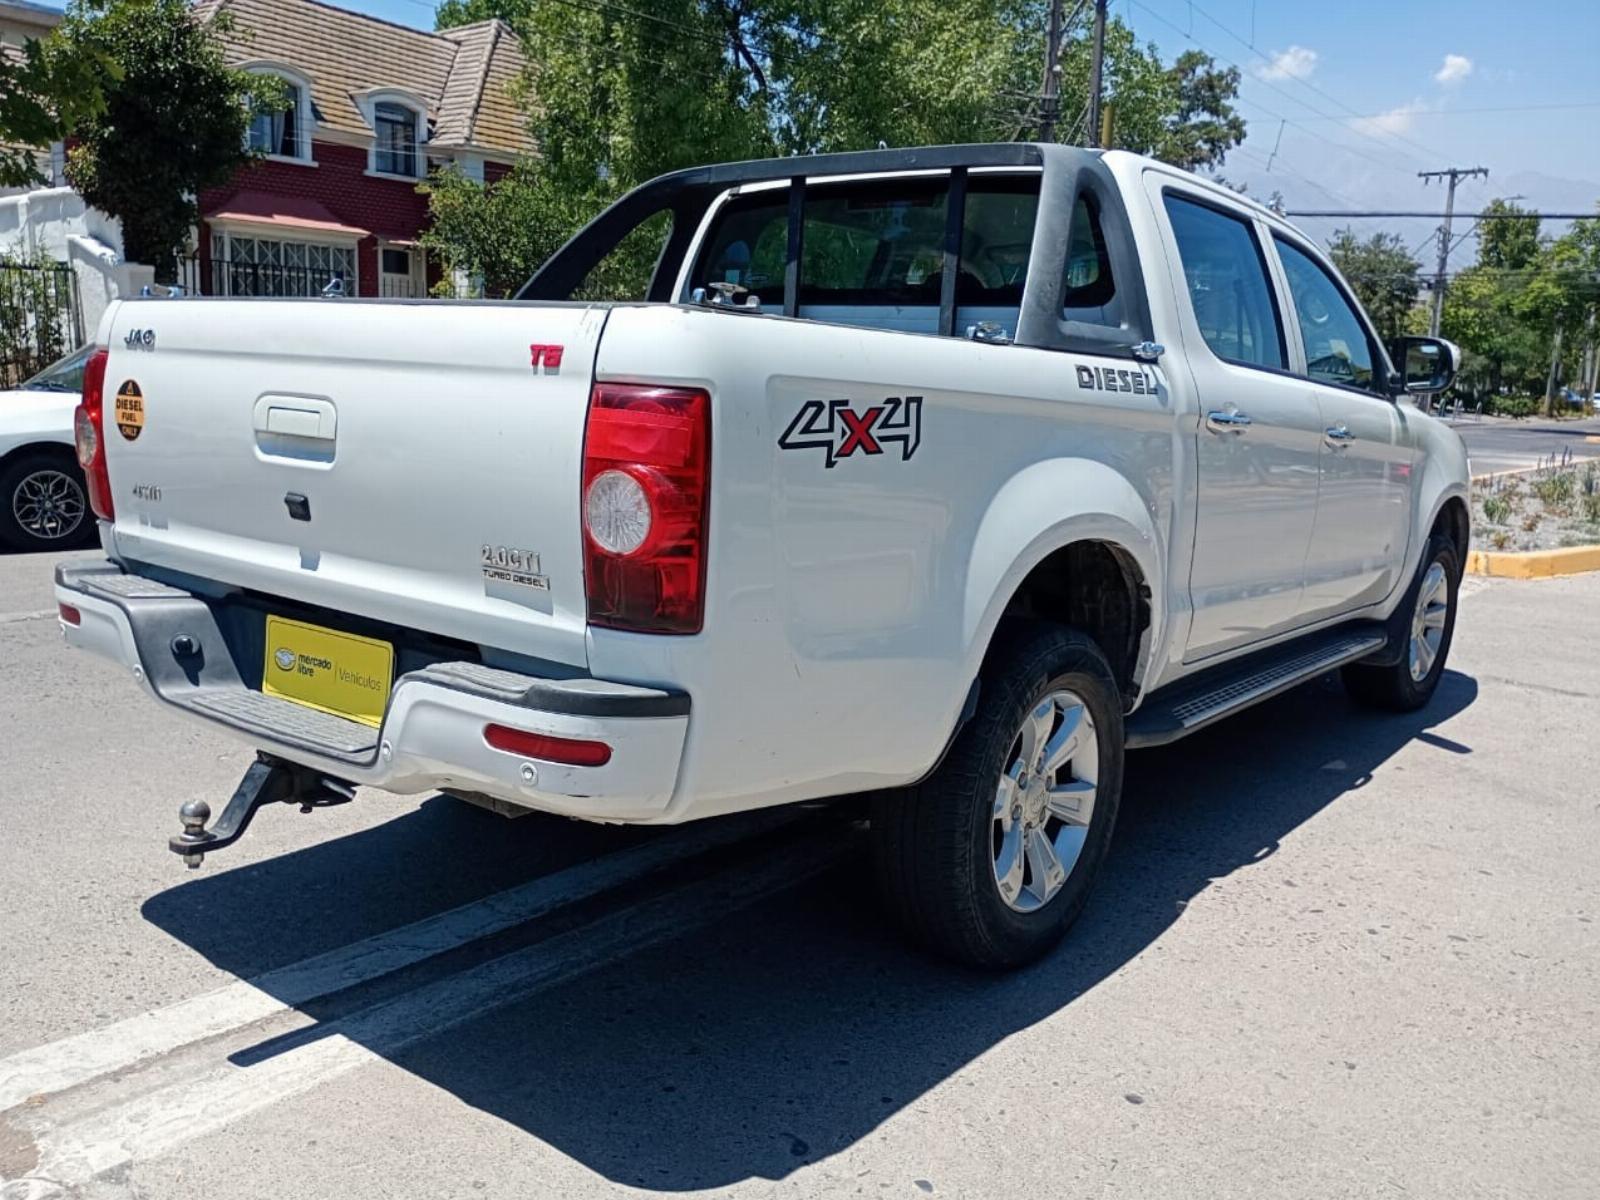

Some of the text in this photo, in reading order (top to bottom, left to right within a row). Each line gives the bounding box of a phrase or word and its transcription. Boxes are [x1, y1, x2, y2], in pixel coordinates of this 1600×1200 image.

[124, 328, 155, 345] JAC
[530, 344, 564, 367] T6
[1074, 363, 1158, 395] DIESEL
[116, 398, 143, 412] DIESEL
[121, 411, 138, 423] FUEL
[482, 569, 545, 587] TURBO DIESEL
[298, 653, 332, 671] mercado
[298, 663, 315, 677] libre
